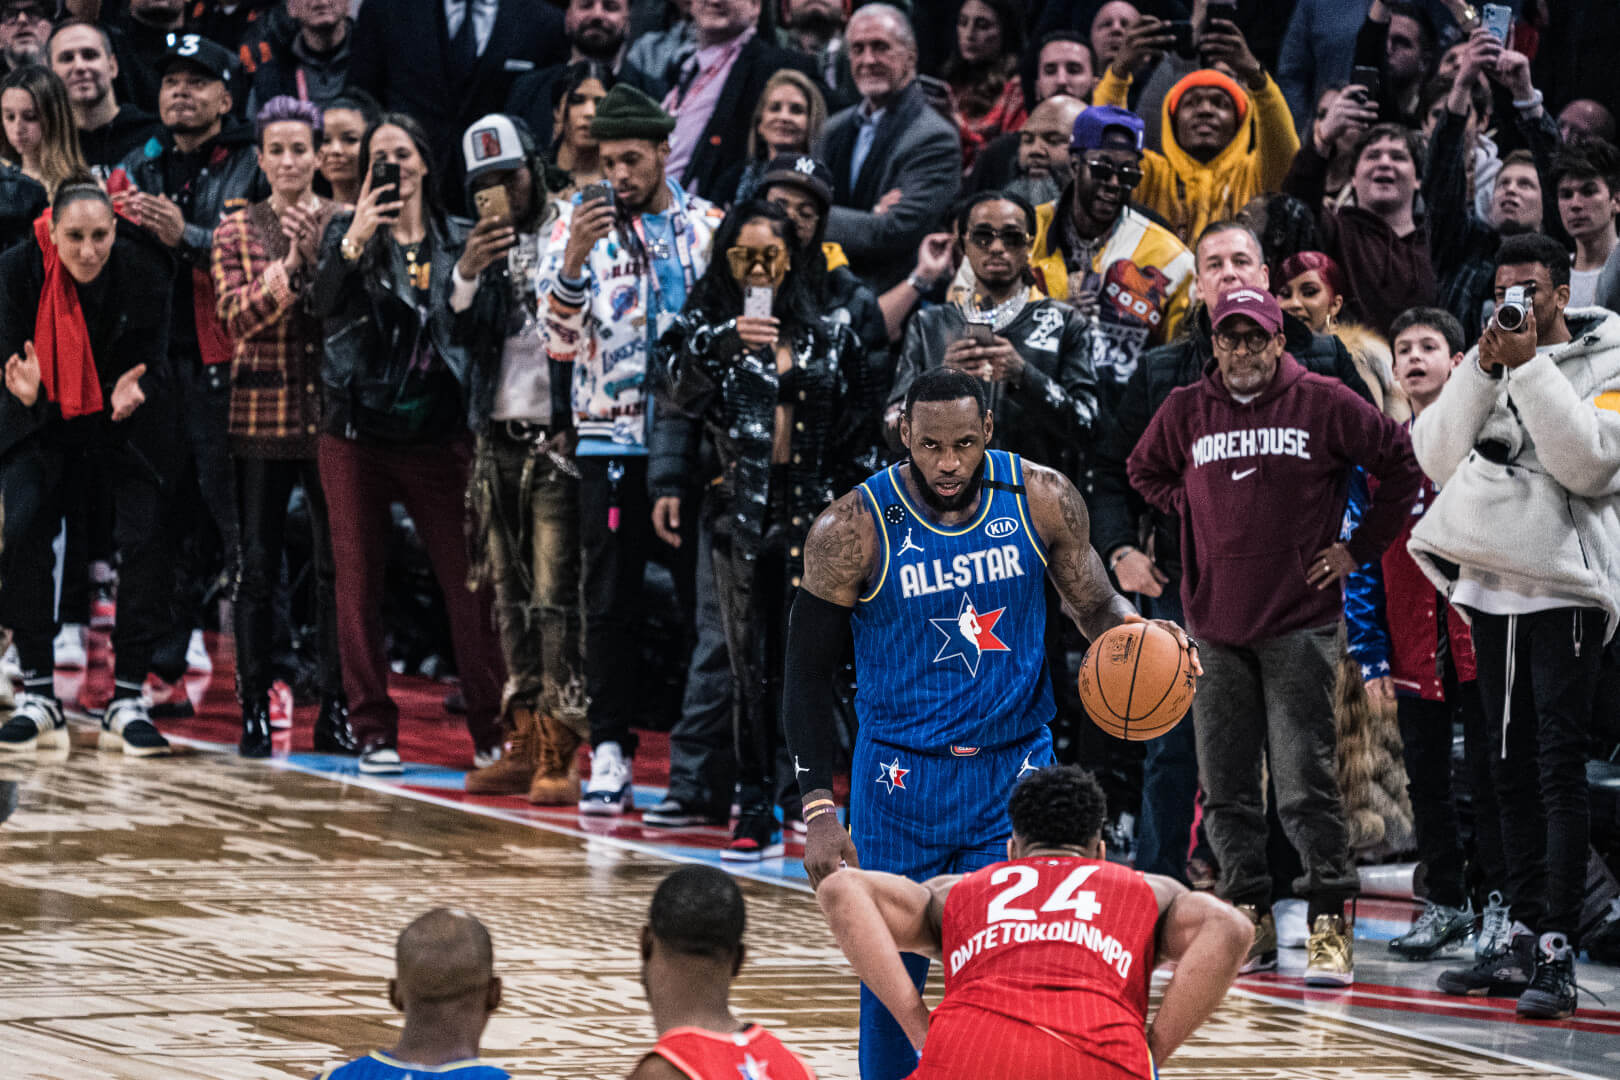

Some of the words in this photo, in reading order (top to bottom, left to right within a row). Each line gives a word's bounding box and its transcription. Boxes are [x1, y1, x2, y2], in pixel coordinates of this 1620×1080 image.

[1192, 427, 1312, 469] MOREHOUSE
[989, 520, 1015, 535] KIA
[900, 544, 1026, 599] ALL-STAR
[986, 865, 1102, 924] 24
